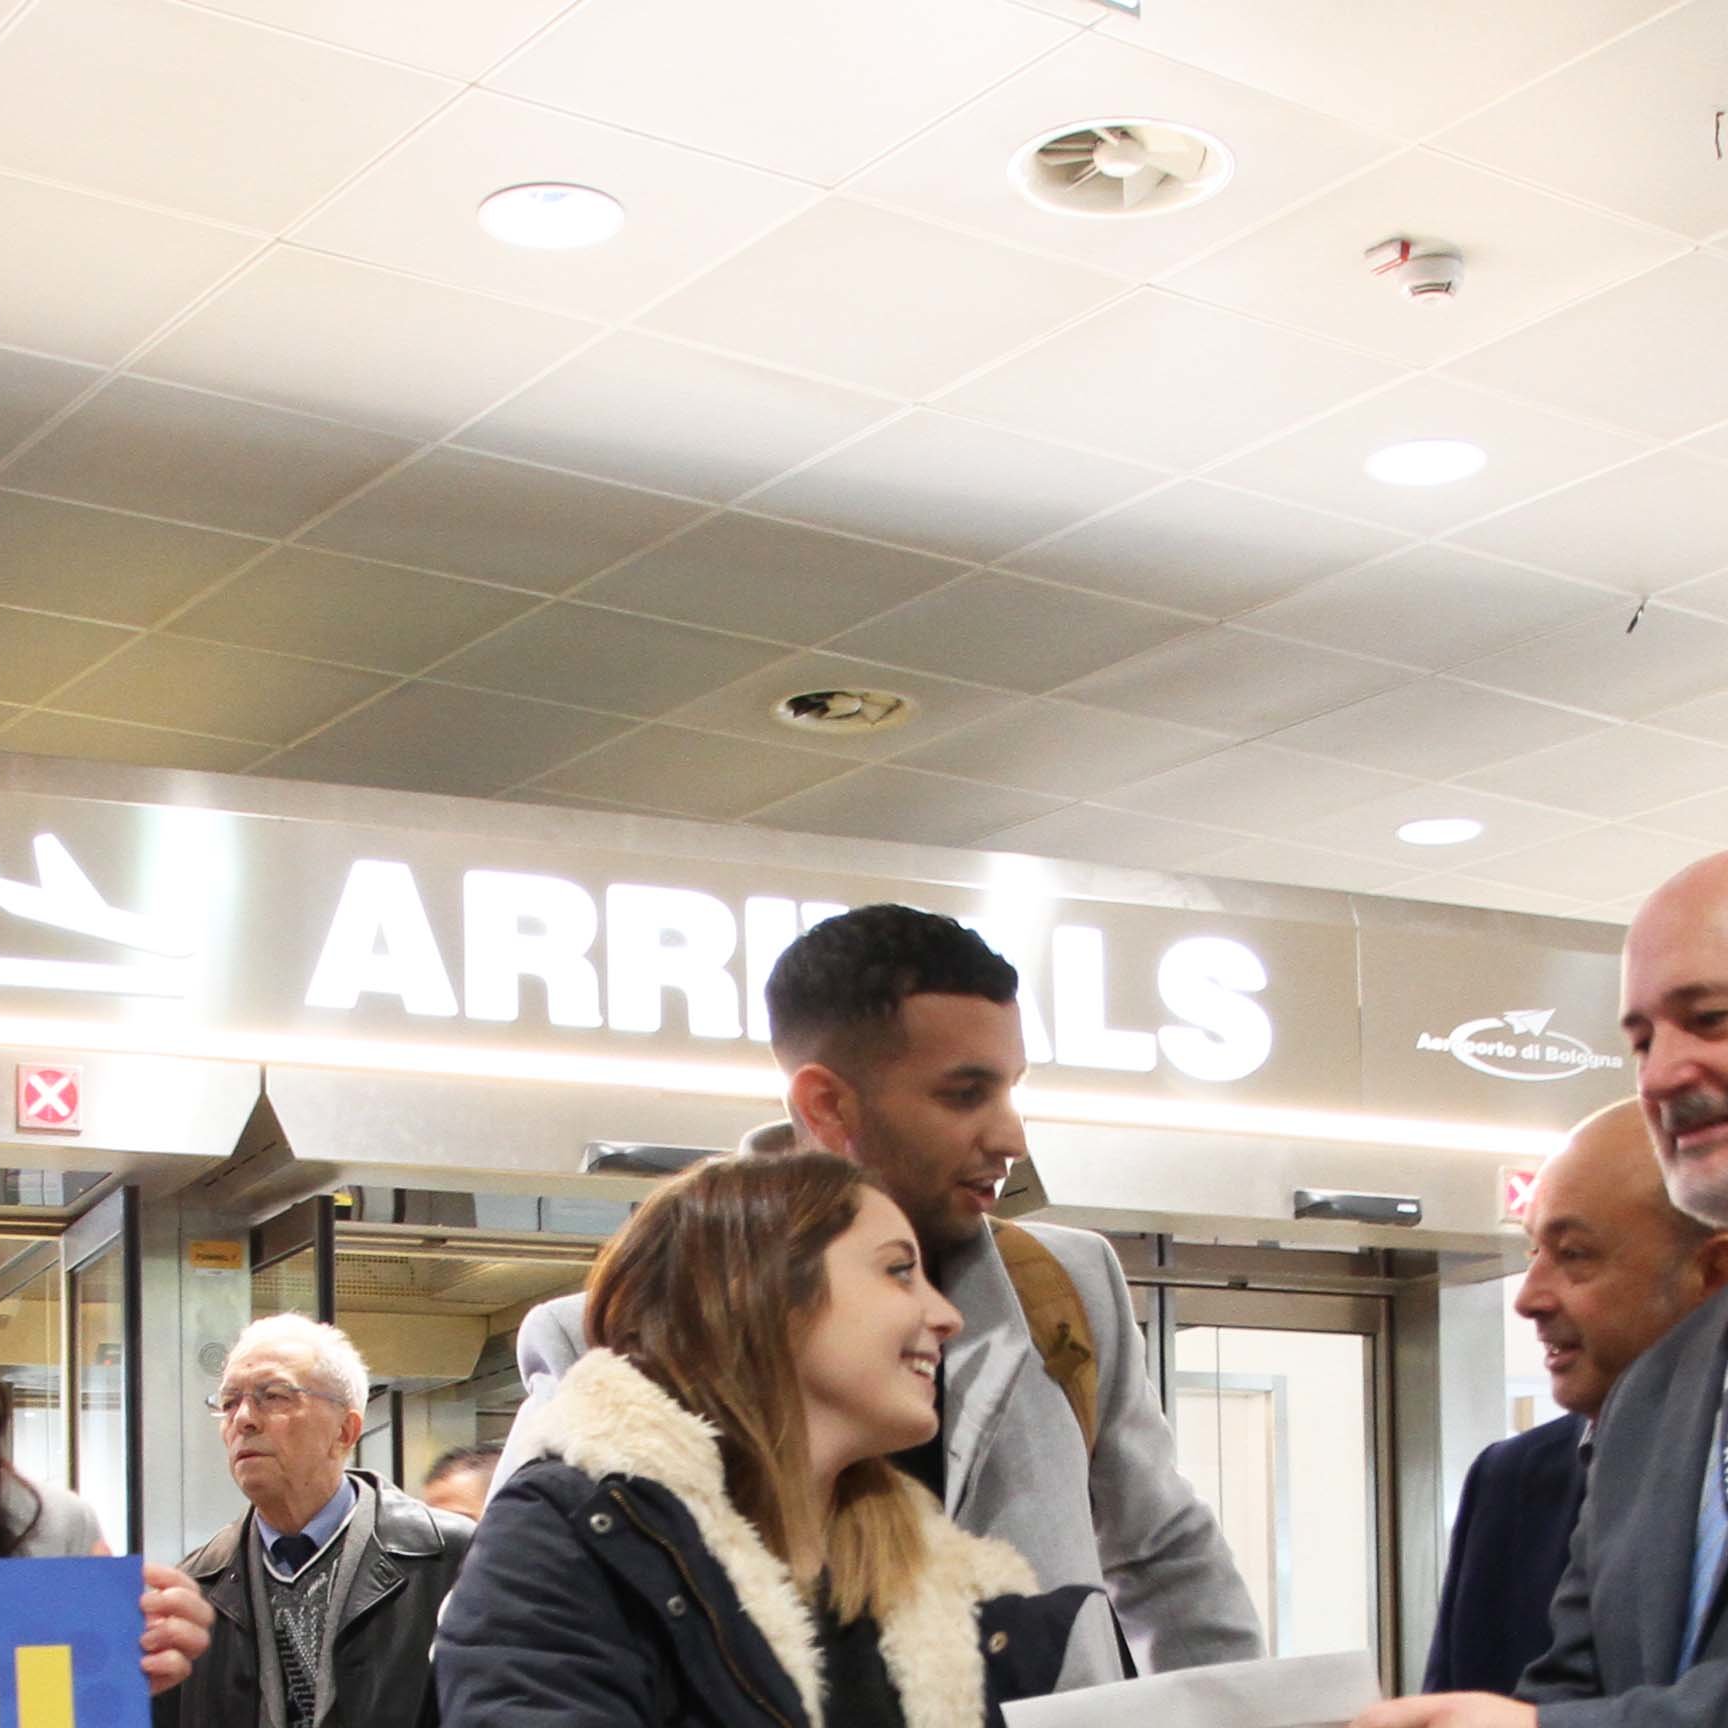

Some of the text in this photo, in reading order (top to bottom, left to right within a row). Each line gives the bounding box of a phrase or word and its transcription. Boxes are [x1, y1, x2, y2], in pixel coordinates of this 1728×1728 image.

[304, 860, 1272, 1082] ARRILS
[1415, 1031, 1624, 1070] Aeroporto di Bologna
